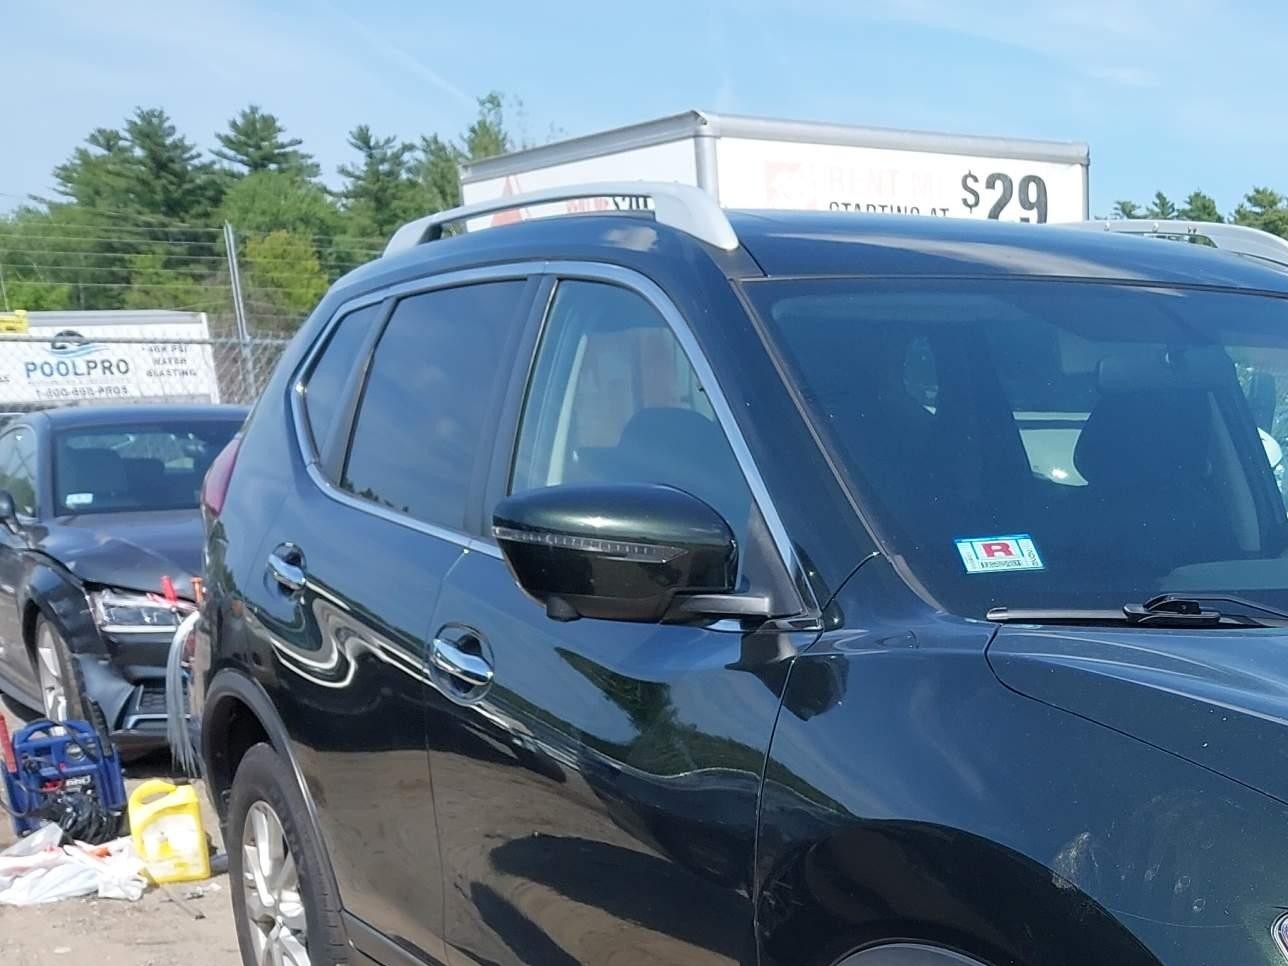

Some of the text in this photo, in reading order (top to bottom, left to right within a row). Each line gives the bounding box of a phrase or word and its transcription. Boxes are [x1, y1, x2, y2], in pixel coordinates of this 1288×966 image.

[960, 169, 1048, 224] $29
[25, 359, 130, 378] POOLPRO
[982, 543, 1013, 557] R
